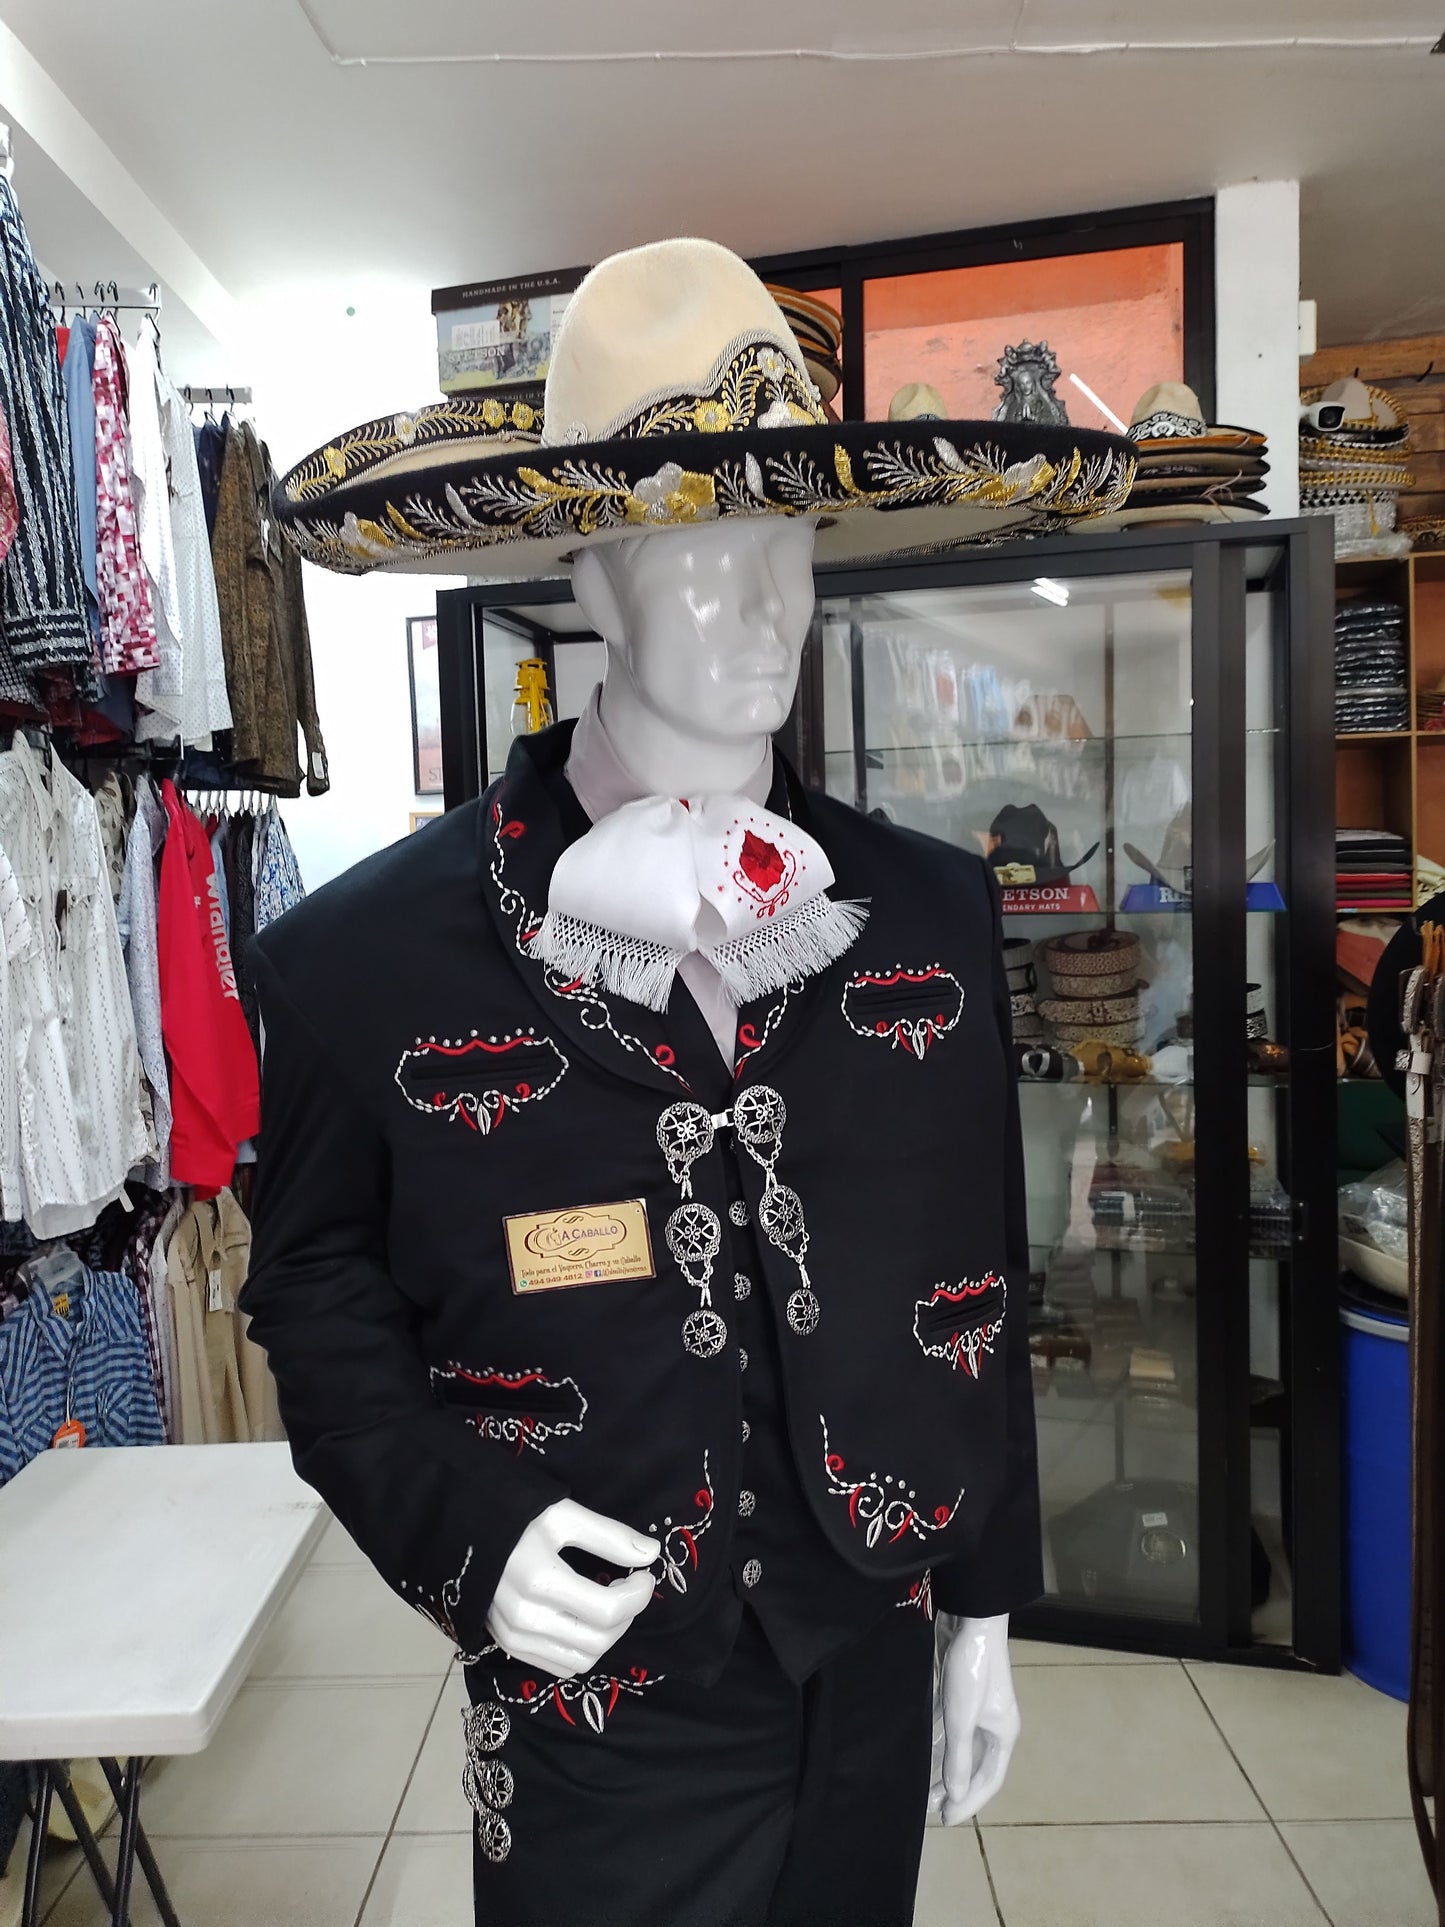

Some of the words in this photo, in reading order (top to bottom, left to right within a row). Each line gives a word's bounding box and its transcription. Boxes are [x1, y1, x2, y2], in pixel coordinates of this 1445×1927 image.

[462, 285, 506, 298] HANDMADE
[508, 283, 518, 292] IN
[519, 280, 535, 290] THE
[447, 346, 506, 364] STETSON
[1038, 902, 1061, 911] HATS
